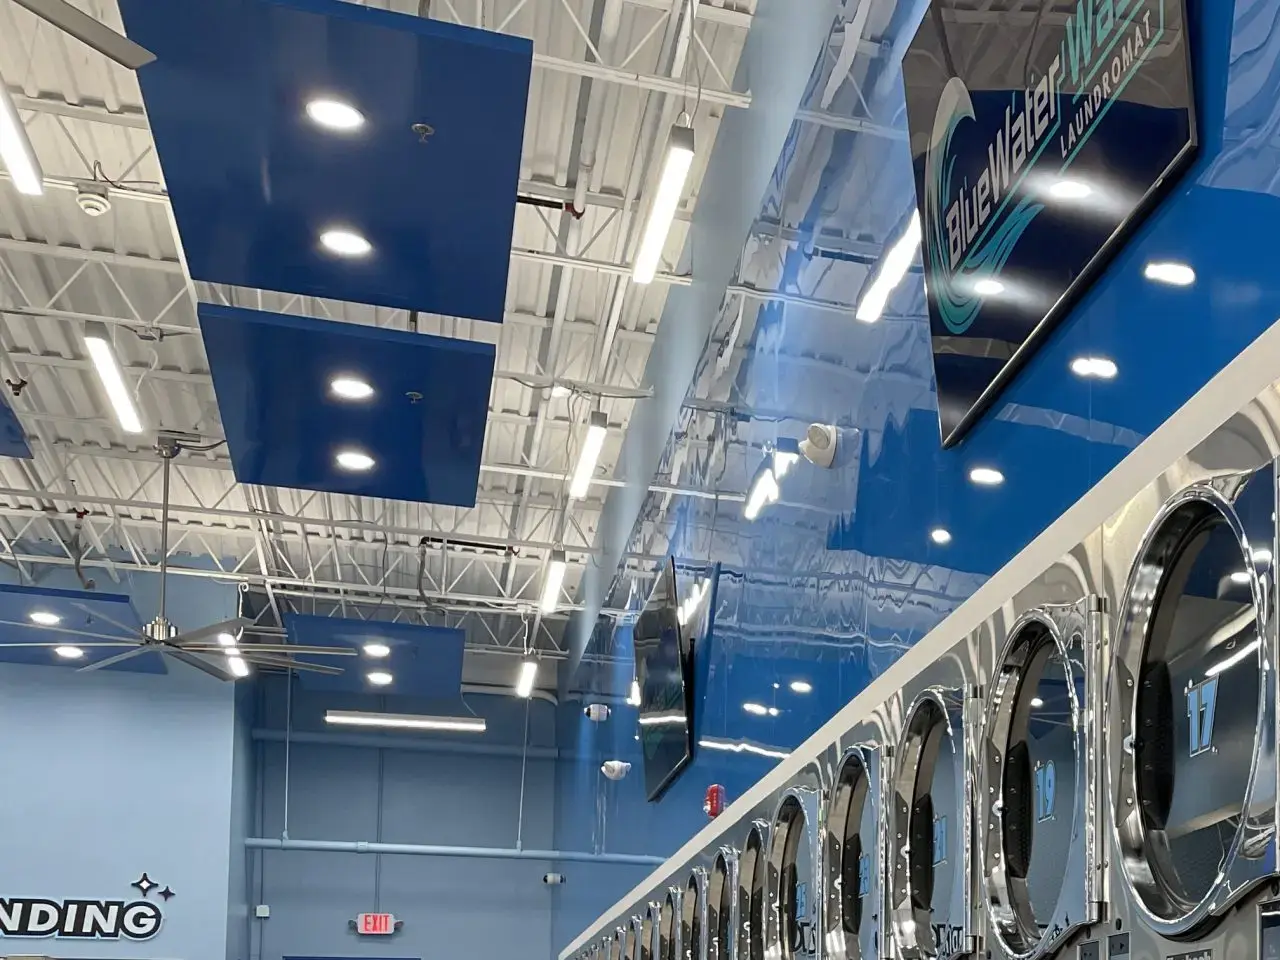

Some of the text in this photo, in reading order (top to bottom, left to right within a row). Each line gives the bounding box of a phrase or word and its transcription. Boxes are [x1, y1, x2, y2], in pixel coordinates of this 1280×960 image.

[1060, 9, 1150, 158] LAUNDROMAT
[946, 55, 1060, 270] BlueWater
[1187, 673, 1220, 757] 17
[1035, 760, 1056, 823] 19
[364, 914, 389, 932] EXIT
